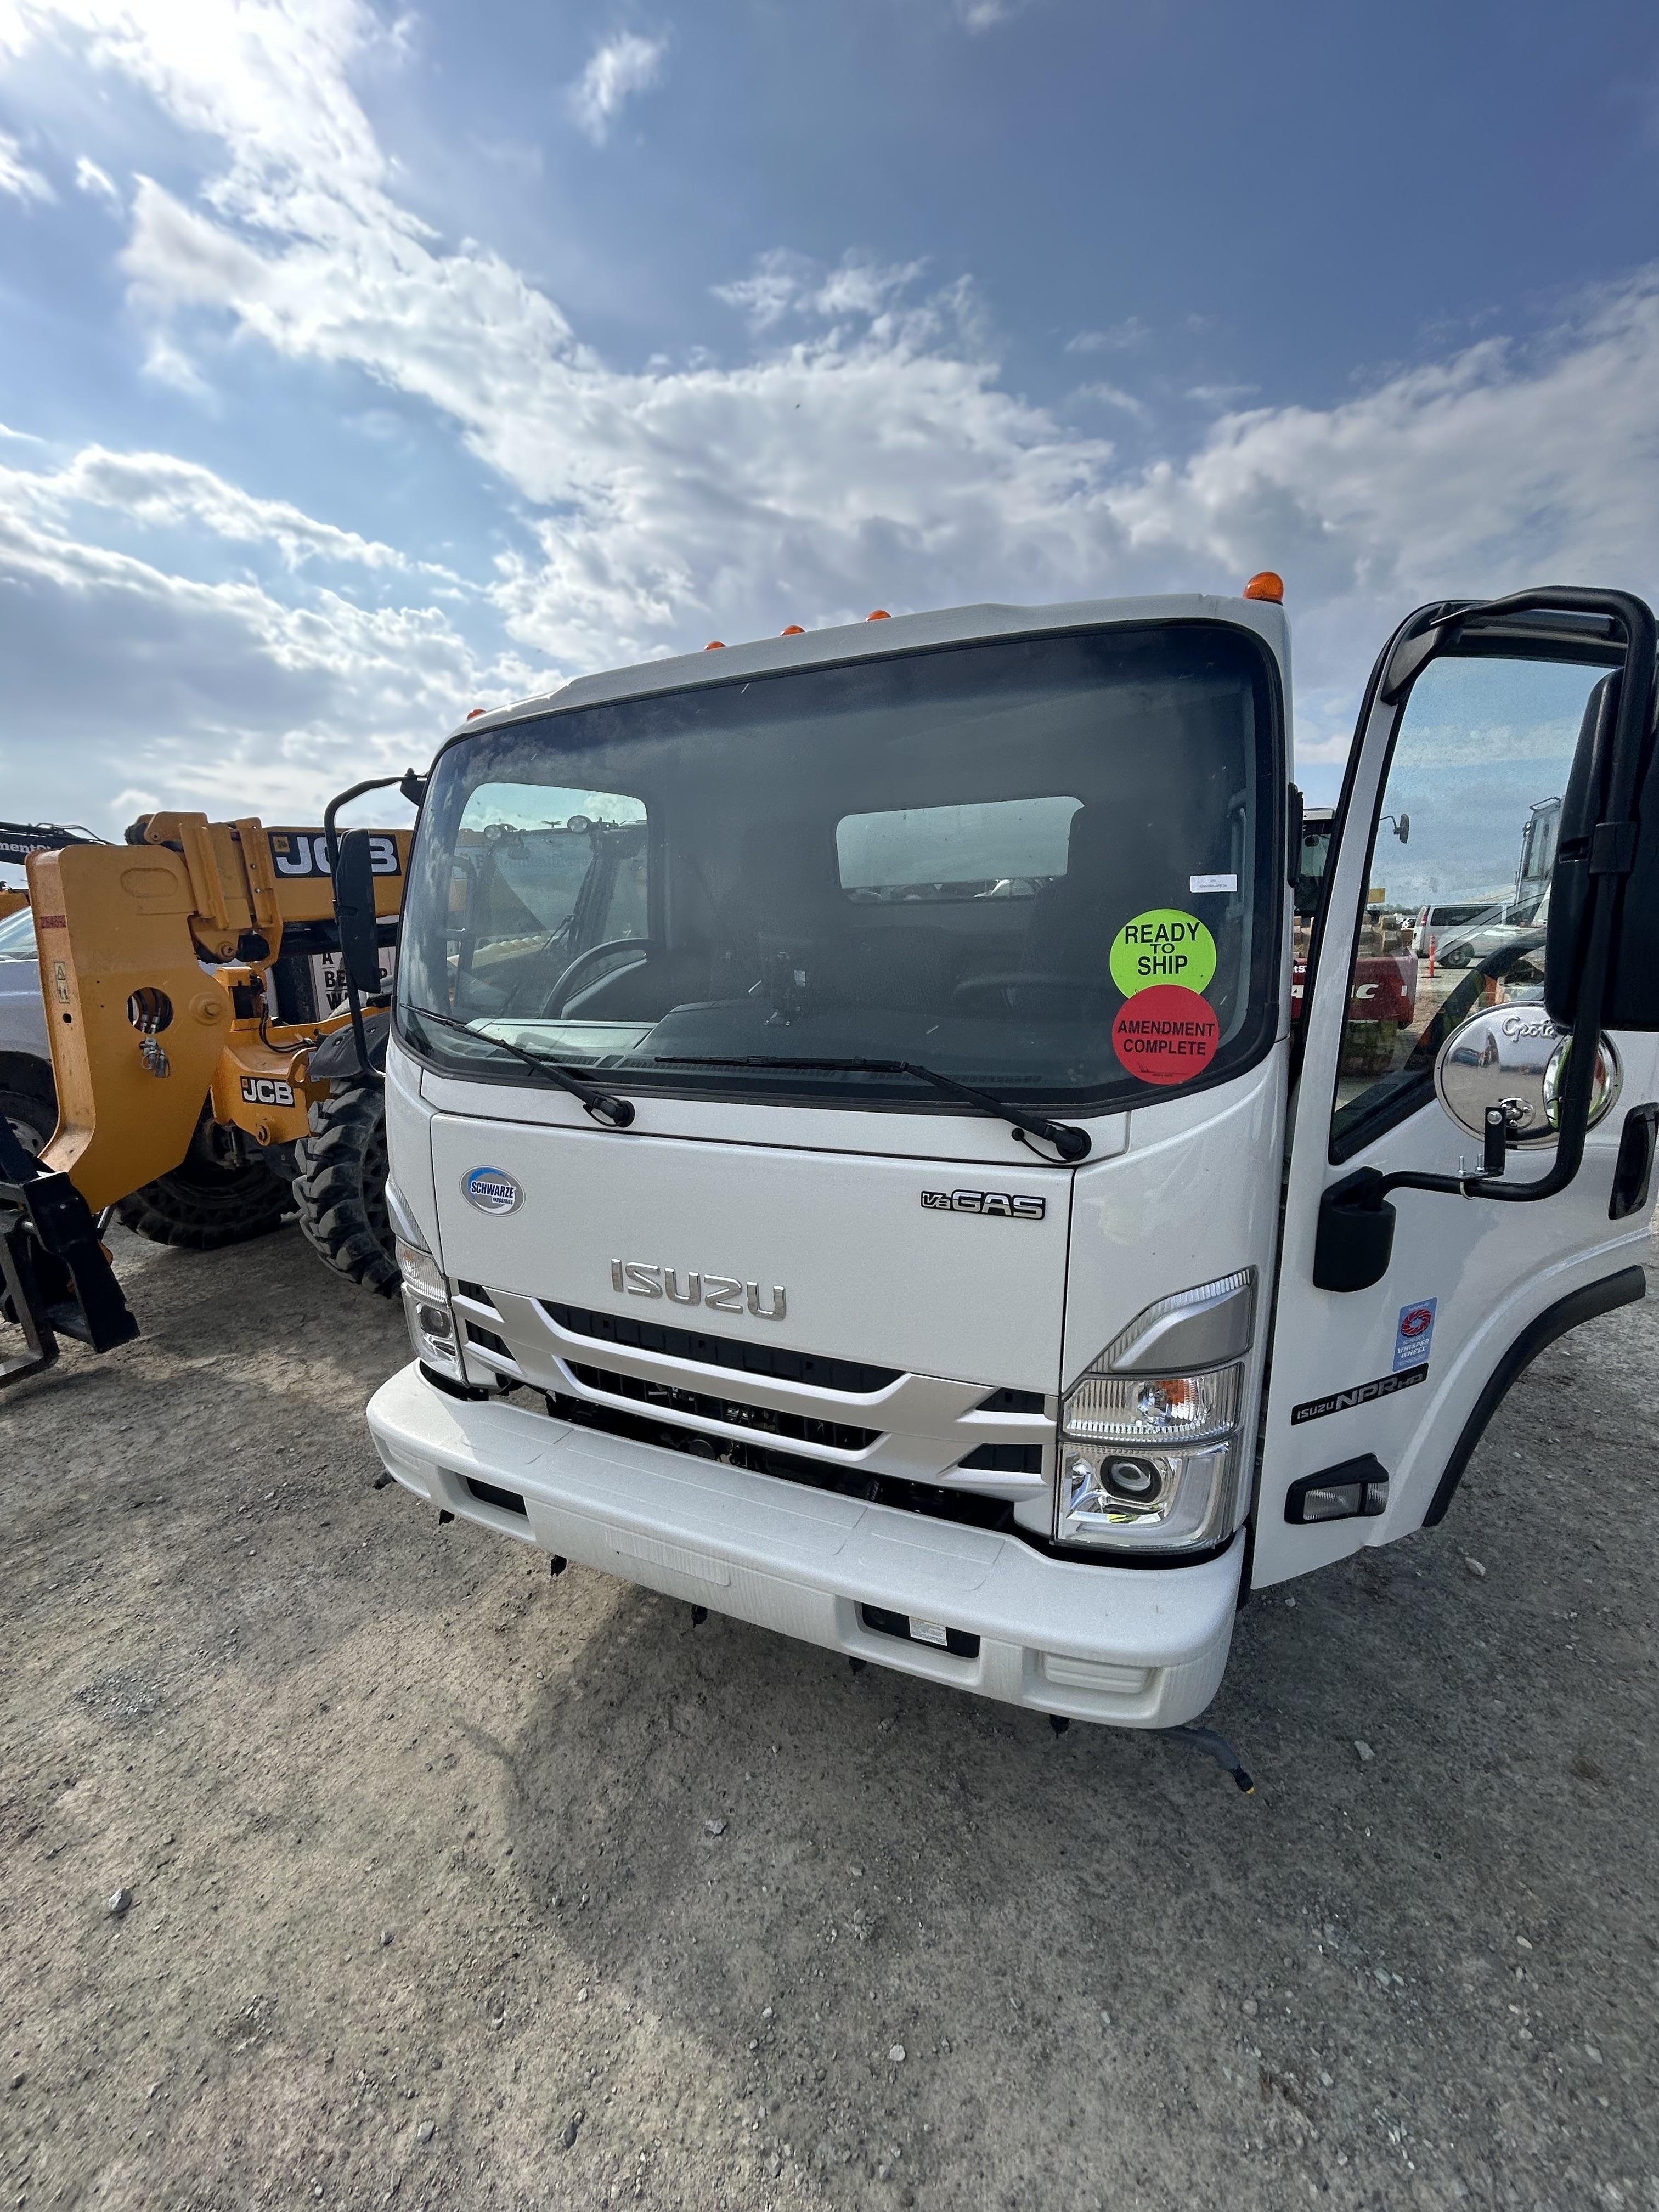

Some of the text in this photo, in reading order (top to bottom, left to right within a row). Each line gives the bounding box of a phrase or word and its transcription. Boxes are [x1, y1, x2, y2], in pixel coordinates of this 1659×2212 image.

[1125, 922, 1200, 944] READY
[1150, 943, 1175, 954] TO
[1138, 955, 1188, 975] SHIP
[1118, 1020, 1215, 1036] AMENDMENT
[1123, 1039, 1206, 1055] COMPLETE
[243, 1079, 294, 1105] JCB
[471, 1181, 514, 1198] SCHWARZE
[923, 1192, 1043, 1219] V8 GAS
[611, 1259, 786, 1321] ISUZU
[1397, 1338, 1430, 1354] WHISPER
[1401, 1346, 1426, 1359] WHEEL
[1297, 1401, 1334, 1420] ISUZU
